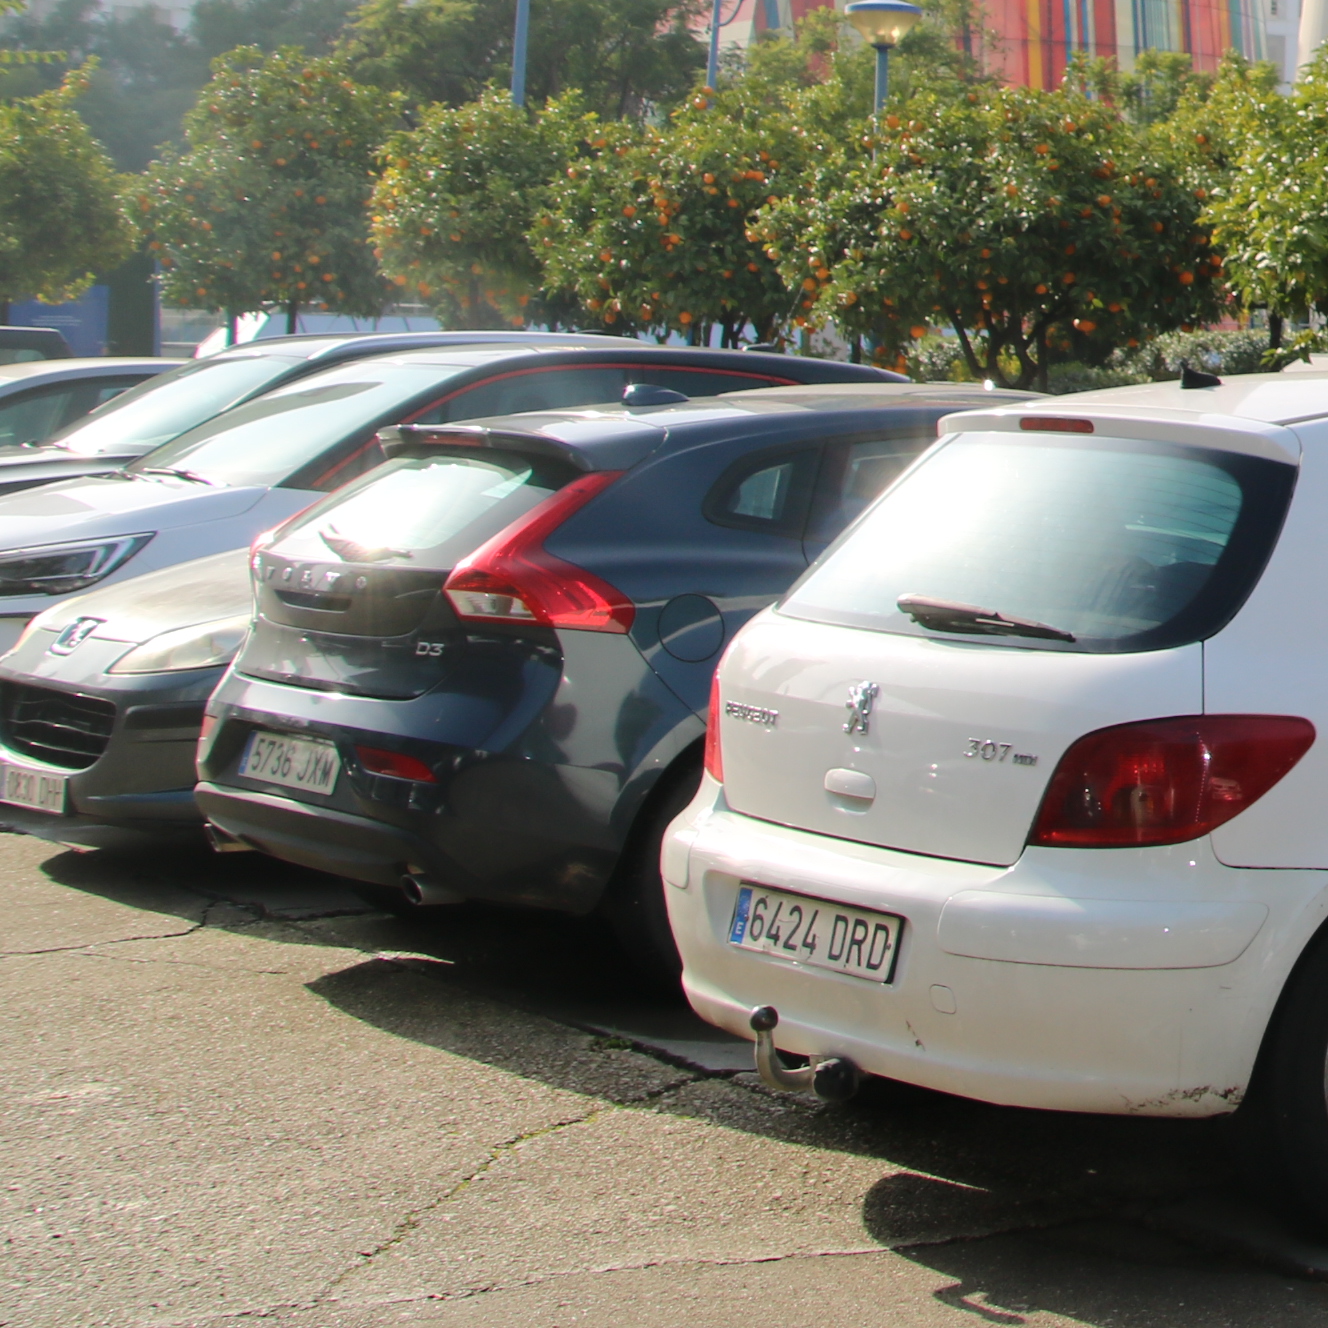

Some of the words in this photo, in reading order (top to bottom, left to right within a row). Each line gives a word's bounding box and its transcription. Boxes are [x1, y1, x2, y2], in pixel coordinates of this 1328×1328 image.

[415, 641, 445, 657] D3
[251, 738, 295, 778] 5736
[297, 750, 335, 788] JXM
[962, 737, 1012, 762] 307
[734, 921, 745, 936] E
[750, 896, 819, 956] 6424
[828, 914, 891, 971] DRD
